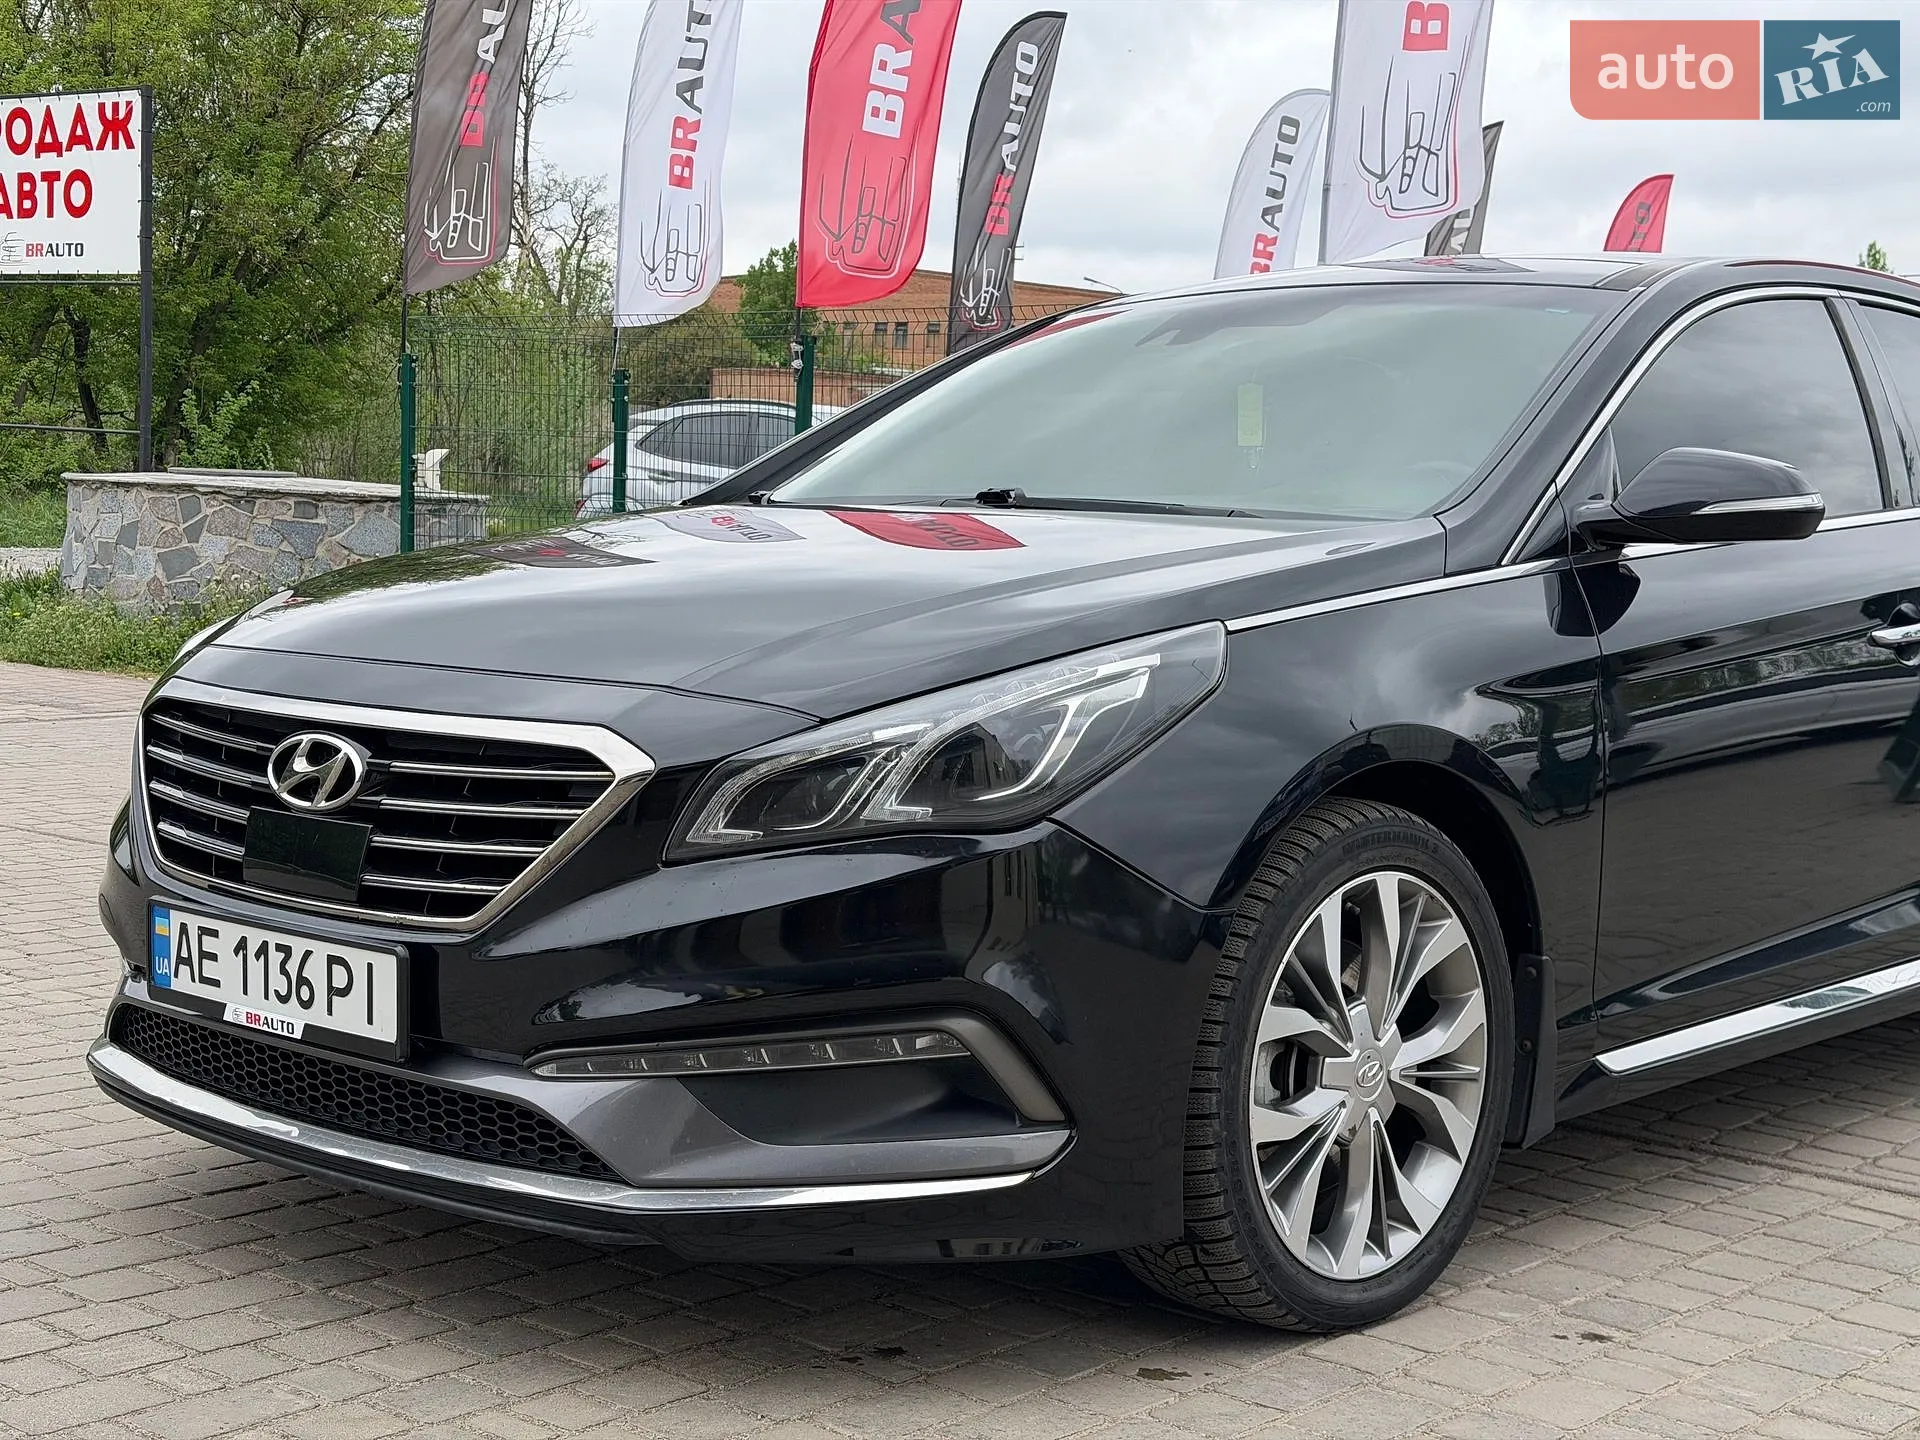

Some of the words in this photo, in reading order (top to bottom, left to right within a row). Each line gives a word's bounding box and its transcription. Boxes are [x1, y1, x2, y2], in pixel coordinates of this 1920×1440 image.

[861, 0, 922, 139] BRA
[0, 100, 135, 159] ОДАЖ
[985, 40, 1040, 236] BRAUTO
[25, 242, 84, 258] BRAUTO
[155, 957, 170, 977] UA
[173, 921, 222, 989] AE
[232, 934, 316, 1011] 1136
[326, 953, 374, 1026] PI
[245, 1011, 295, 1035] BRAUTO
